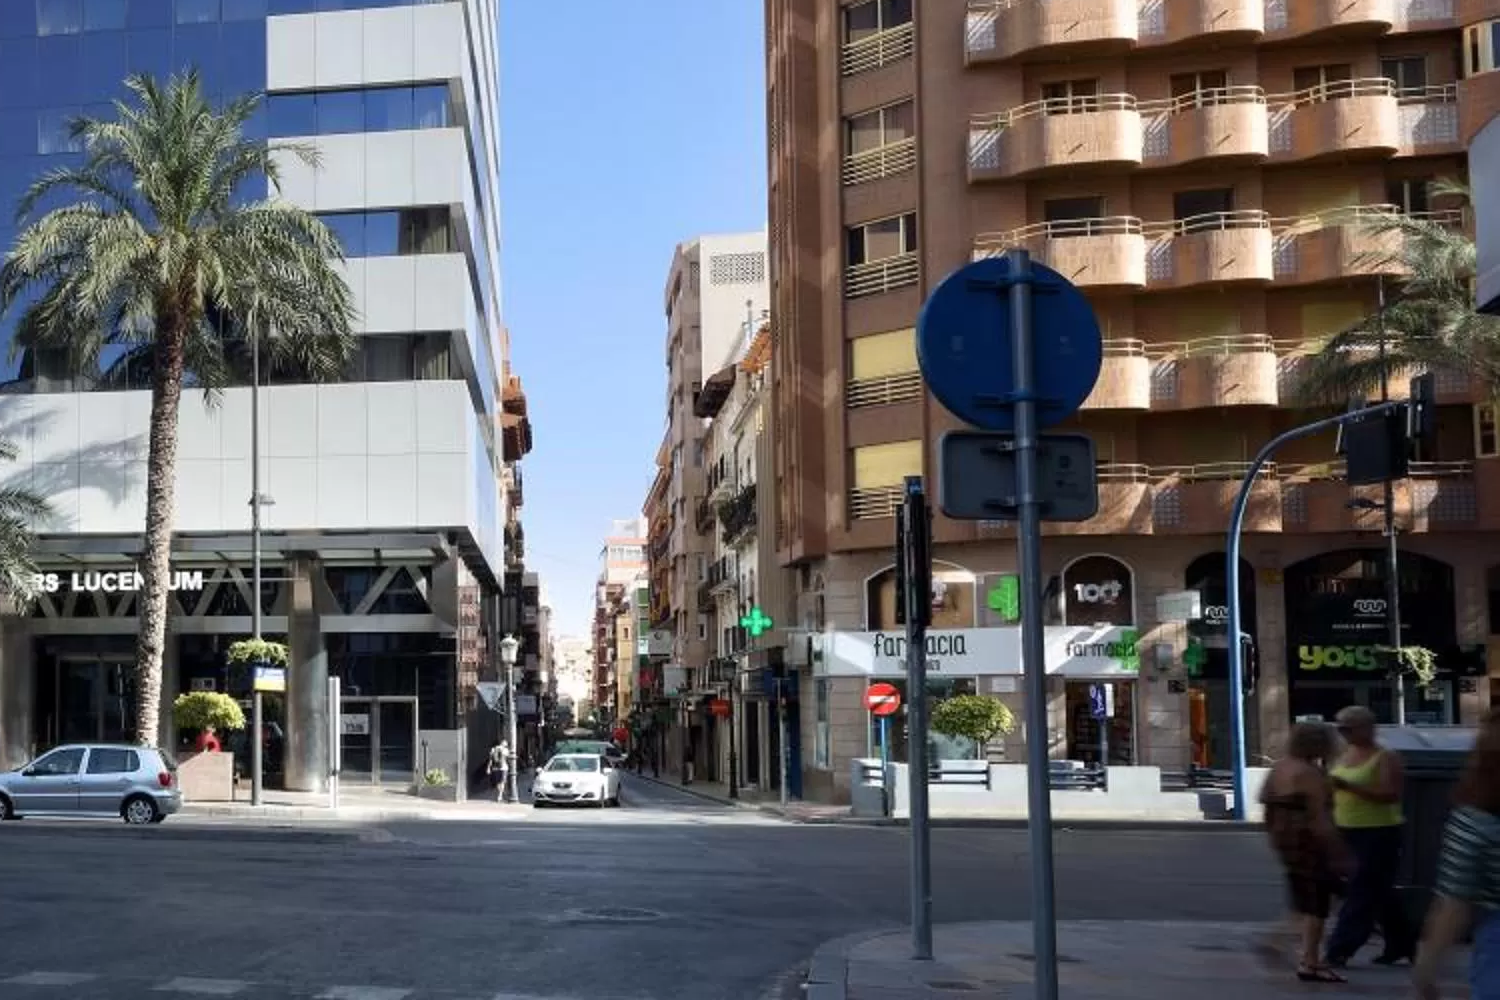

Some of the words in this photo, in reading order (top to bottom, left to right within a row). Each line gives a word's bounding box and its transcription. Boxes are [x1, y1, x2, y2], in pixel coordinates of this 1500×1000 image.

[71, 571, 203, 592] LUCENUM
[874, 632, 967, 657] faracia
[1066, 639, 1136, 657] farmacia
[1298, 645, 1384, 671] yoig
